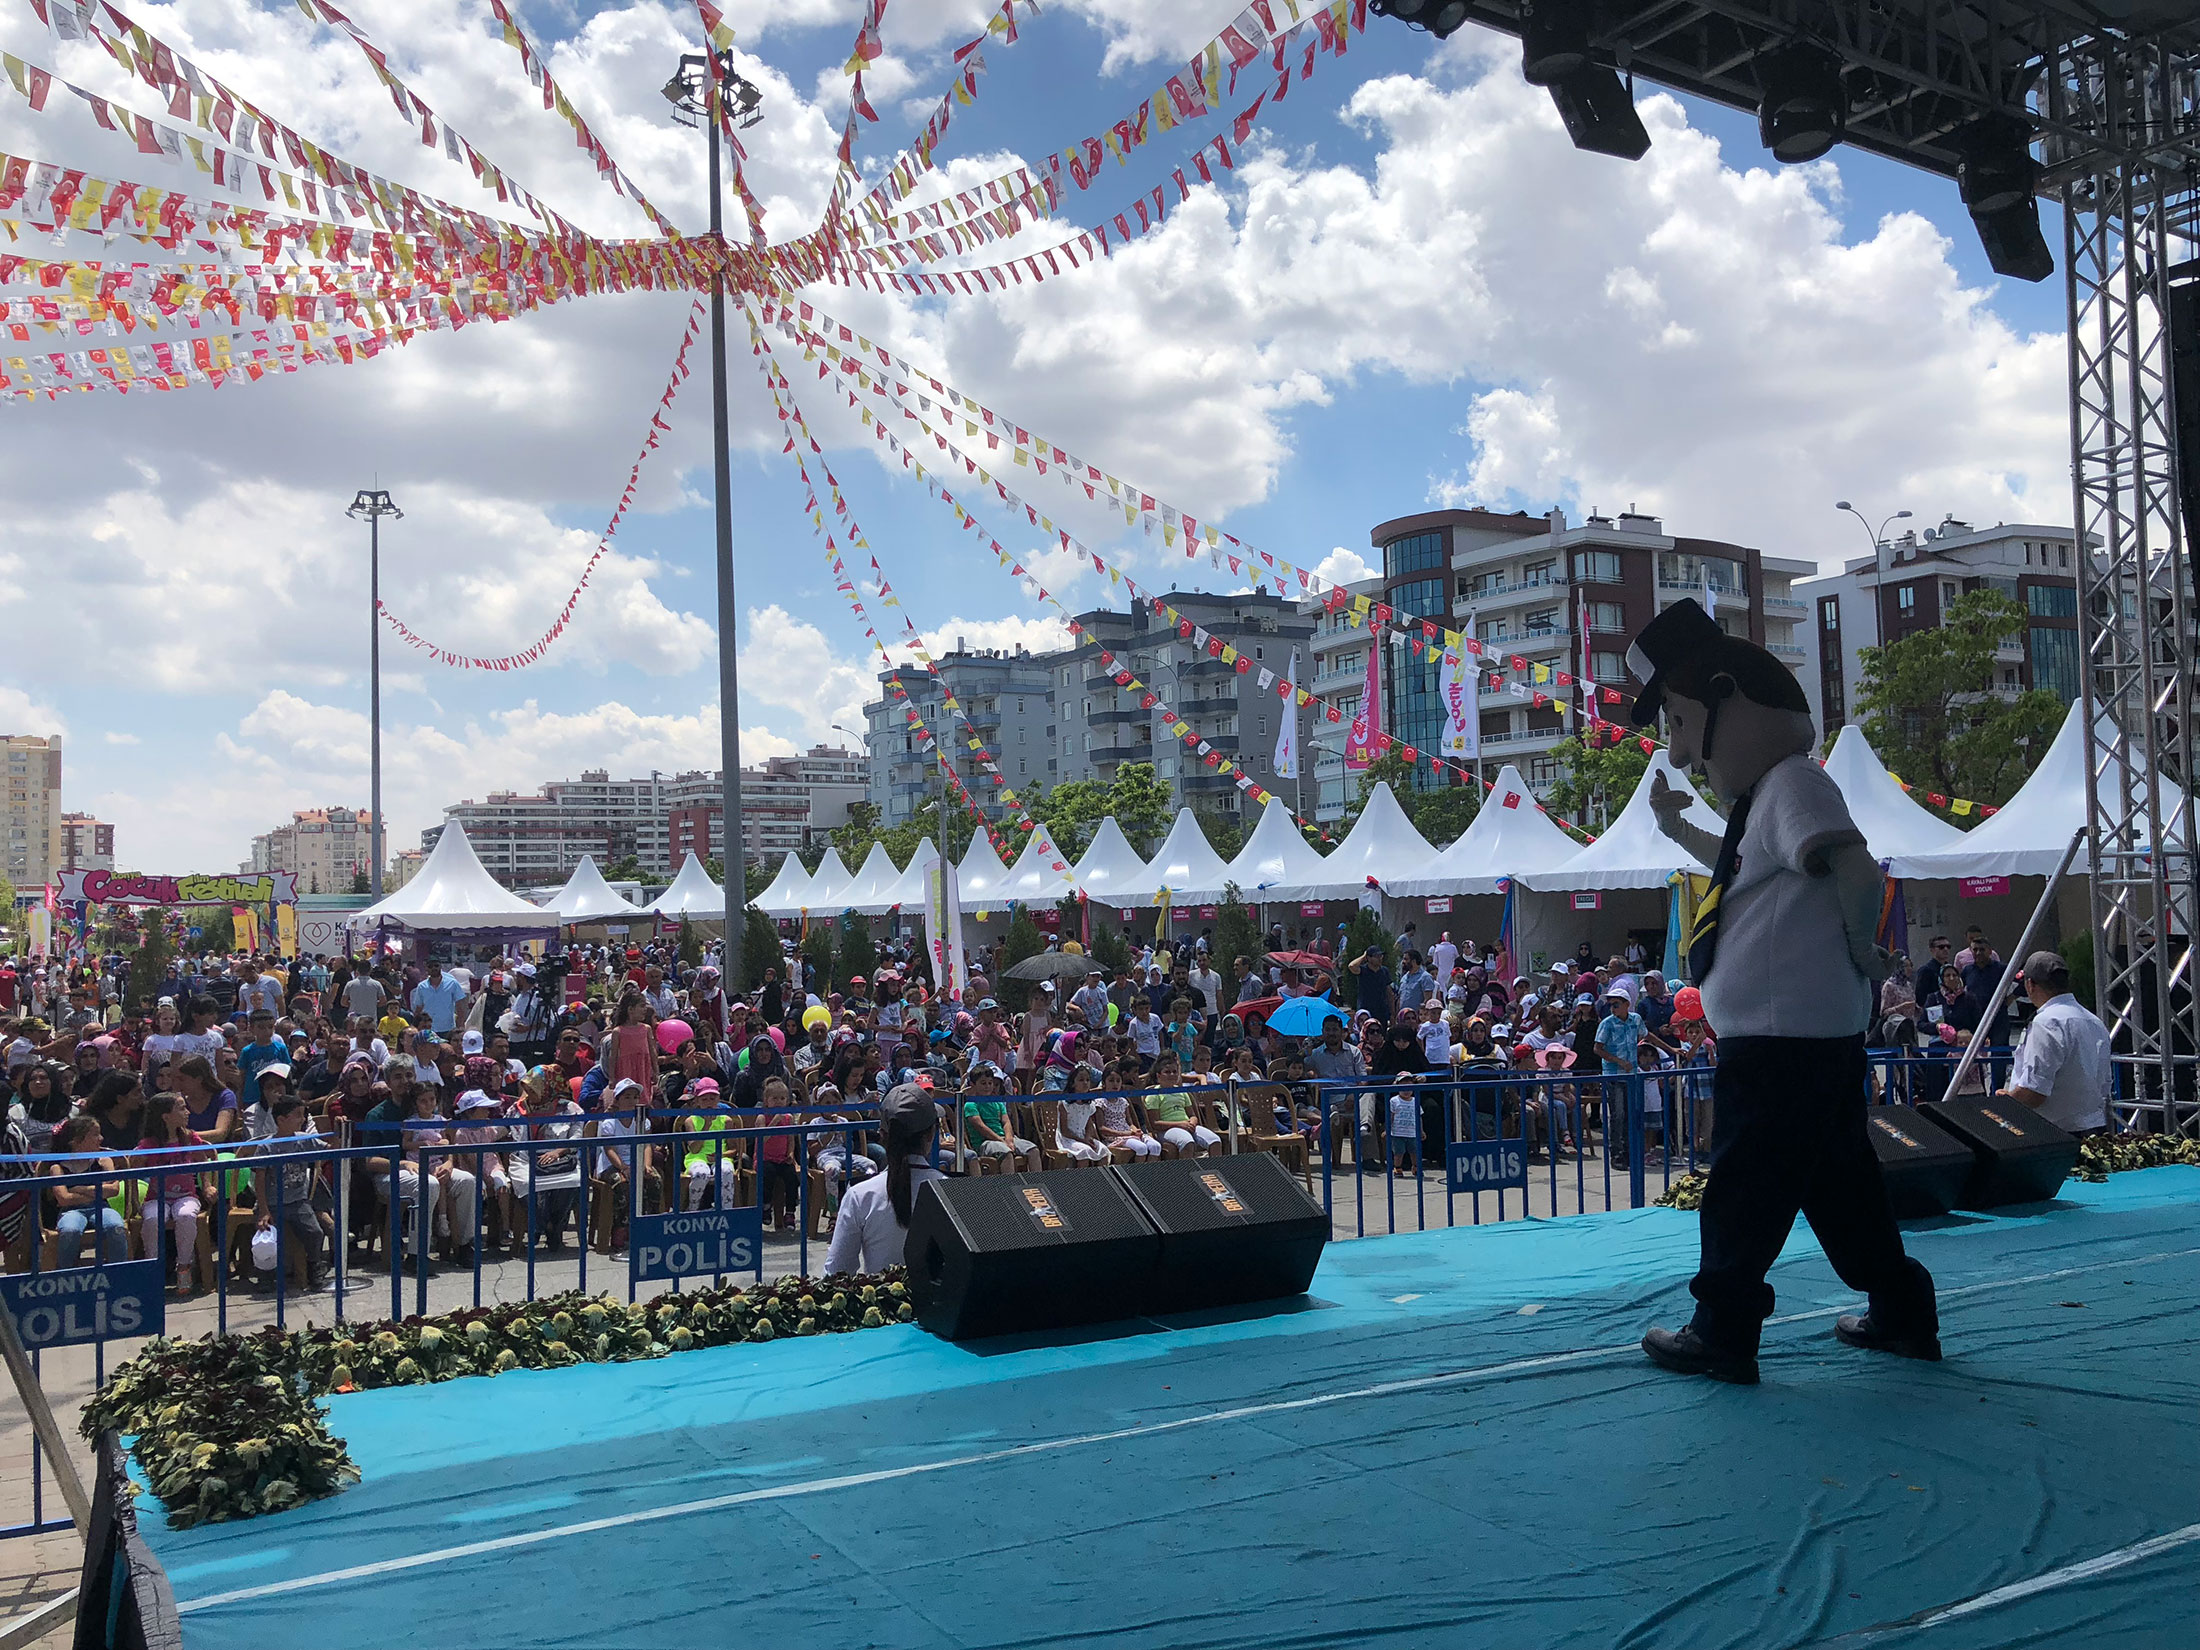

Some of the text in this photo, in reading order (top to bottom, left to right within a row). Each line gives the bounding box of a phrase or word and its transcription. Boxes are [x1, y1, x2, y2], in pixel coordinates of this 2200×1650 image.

[82, 869, 181, 904] Çocuk
[1456, 1147, 1521, 1183] POLİS
[663, 1215, 730, 1235] KONYA
[638, 1232, 753, 1277] POLİS
[18, 1272, 111, 1299] KONYA
[10, 1291, 143, 1342] OLİS
